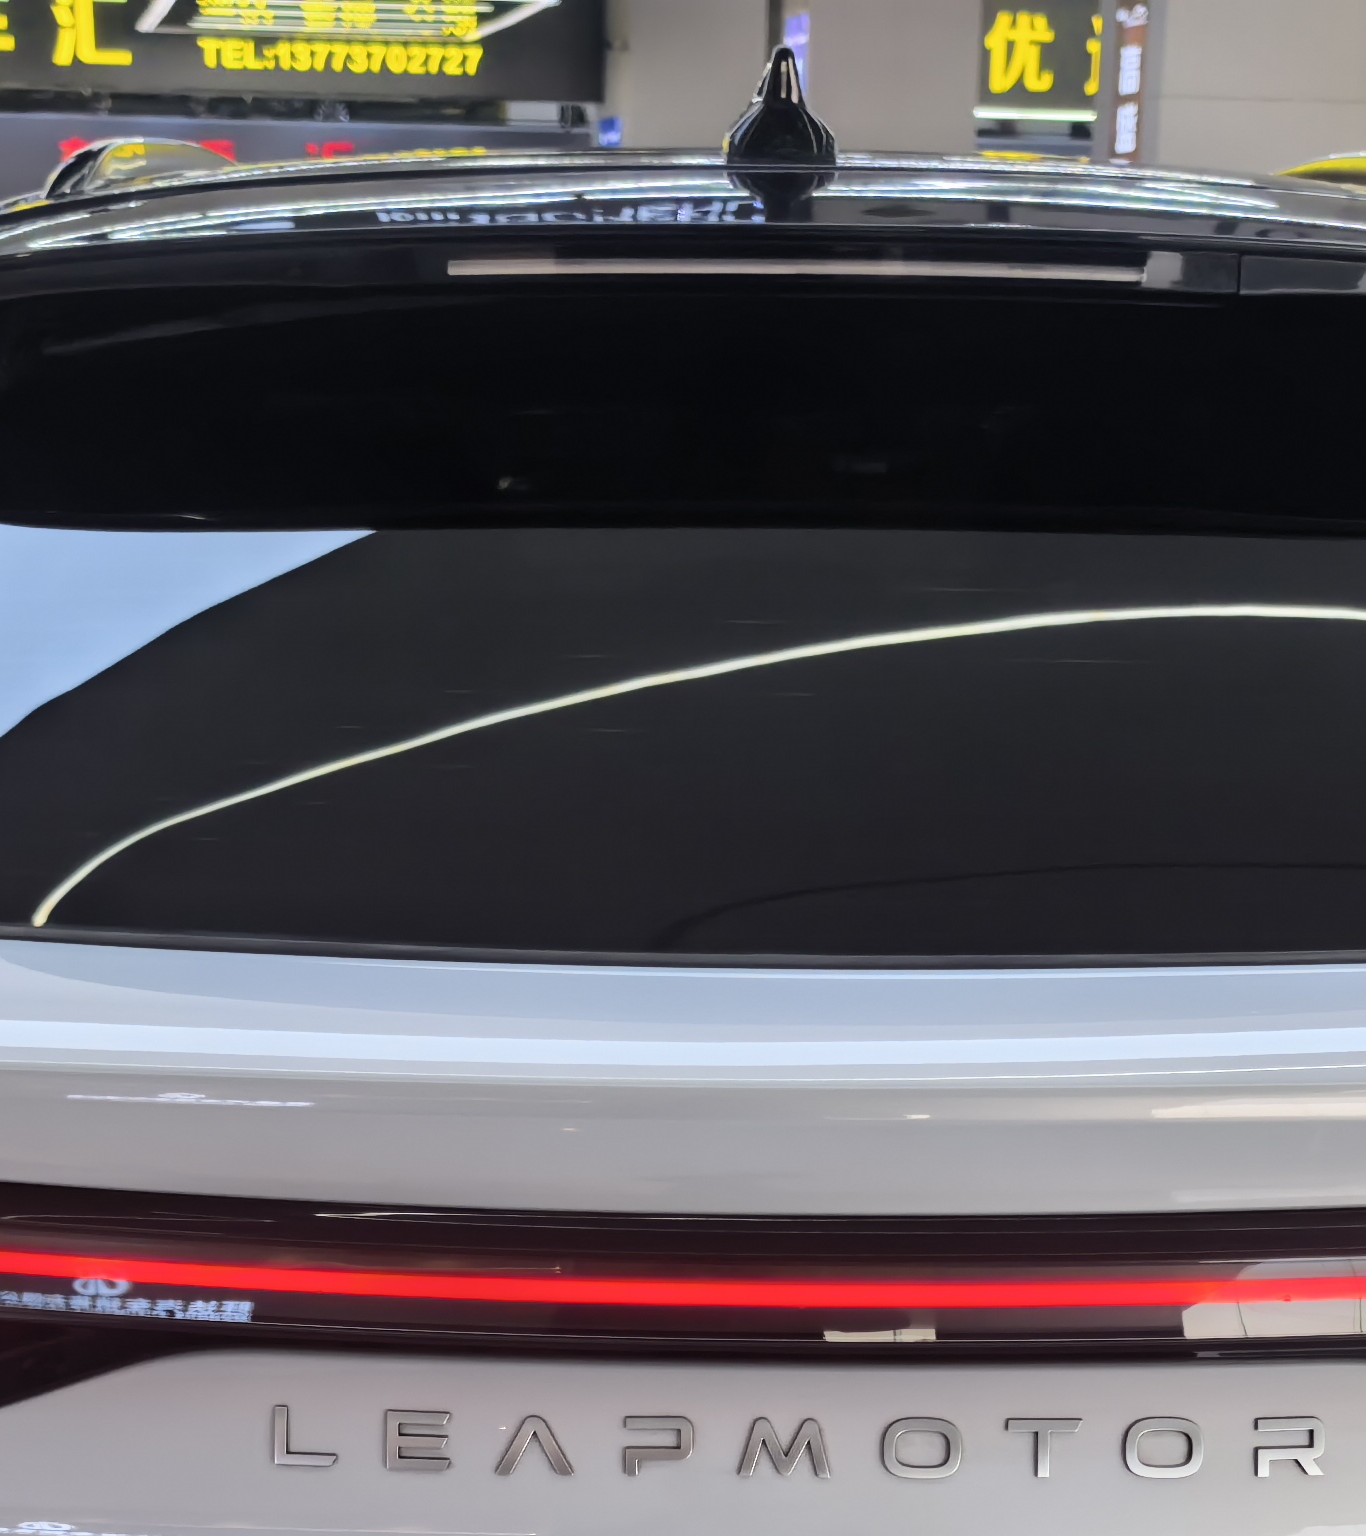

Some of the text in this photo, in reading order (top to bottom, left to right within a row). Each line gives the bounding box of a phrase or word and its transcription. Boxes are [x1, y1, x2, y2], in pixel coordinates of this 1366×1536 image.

[196, 37, 483, 76] TEL:13773702727
[984, 10, 1103, 95] 优
[273, 1403, 1327, 1479] LEAPMOTOR
